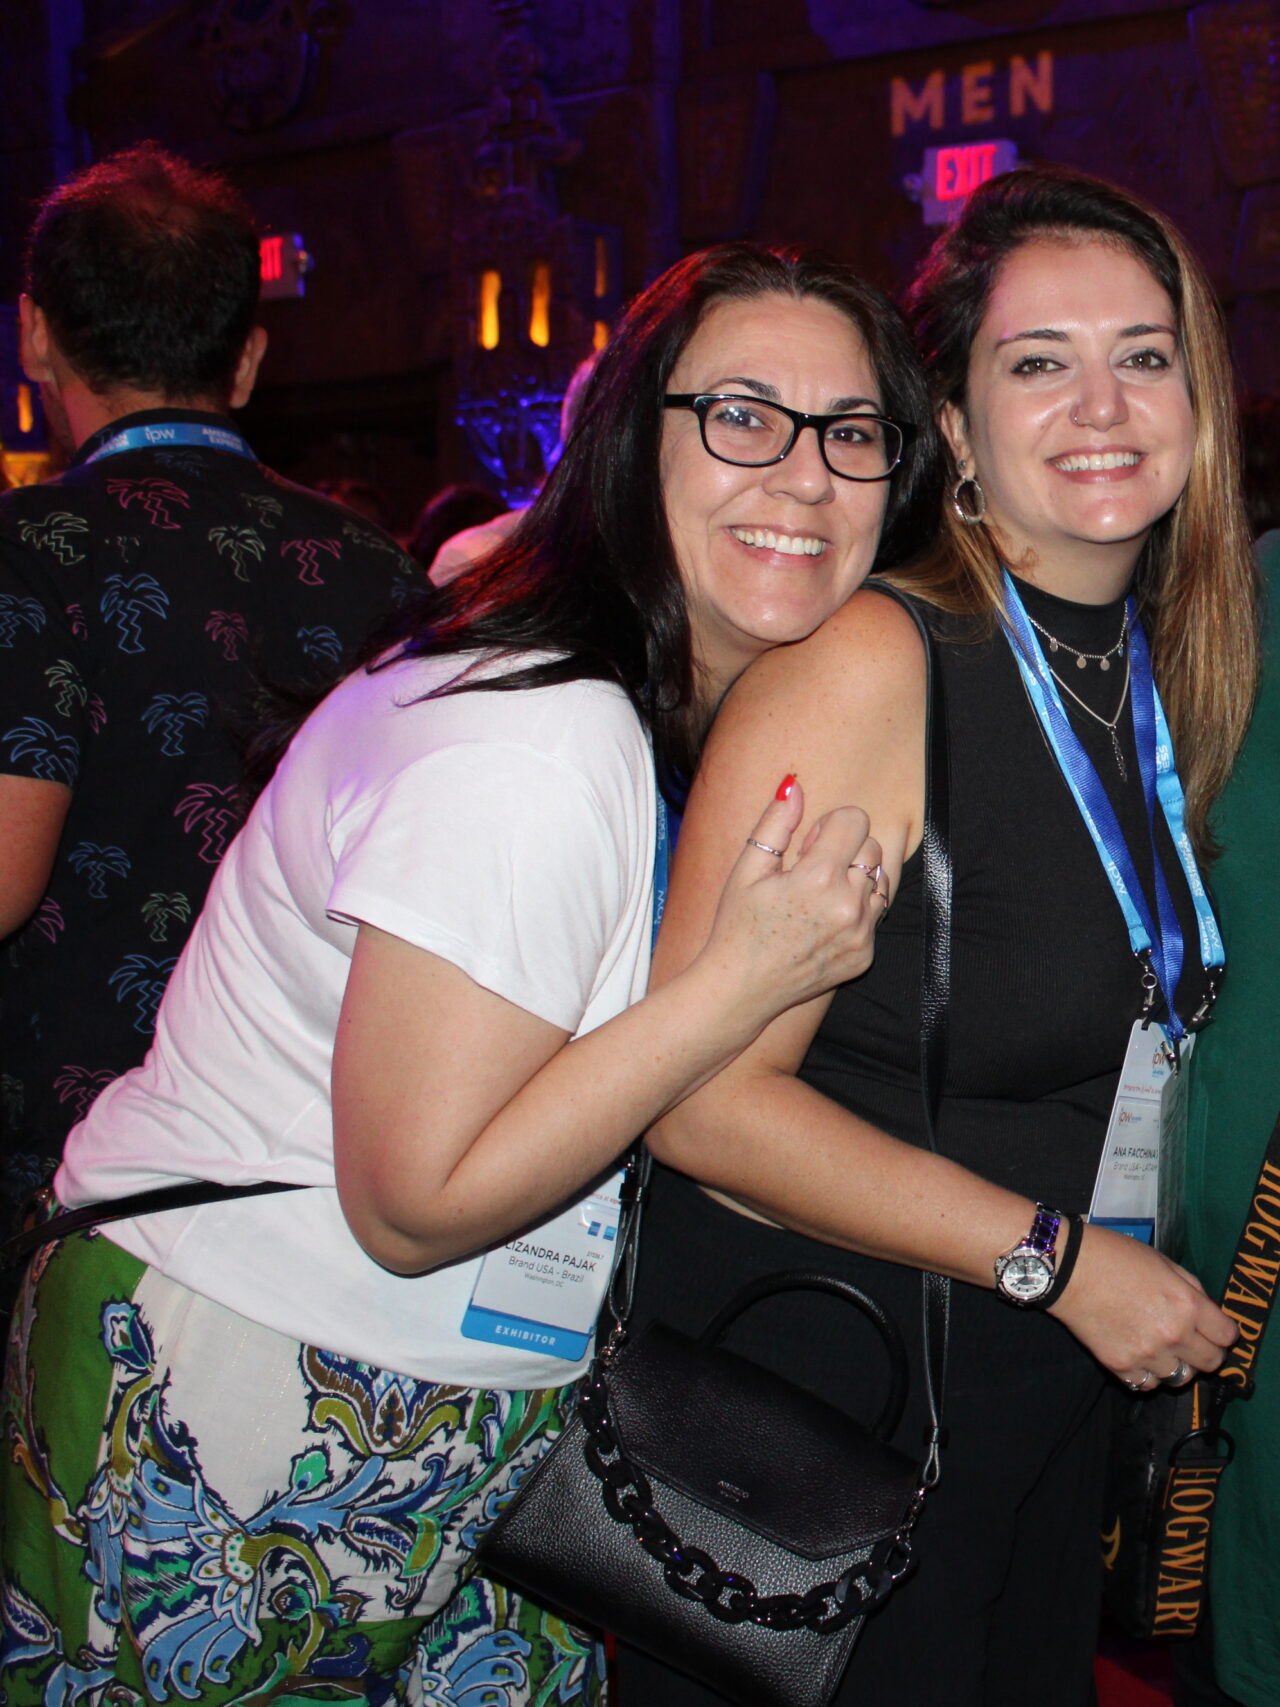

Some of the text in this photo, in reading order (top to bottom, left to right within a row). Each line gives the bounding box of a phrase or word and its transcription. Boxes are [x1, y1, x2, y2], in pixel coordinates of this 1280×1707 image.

[891, 52, 1053, 136] MEN
[936, 143, 998, 201] EXIT
[144, 426, 175, 443] ipw
[1108, 861, 1128, 895] ipw
[1204, 915, 1221, 949] ipw
[1113, 1146, 1127, 1158] ANA
[508, 1255, 535, 1271] Brand
[535, 1262, 555, 1276] USA
[561, 1270, 585, 1283] Brazil
[562, 1254, 597, 1273] PAJAK
[495, 1325, 556, 1346] EXHIBITOR
